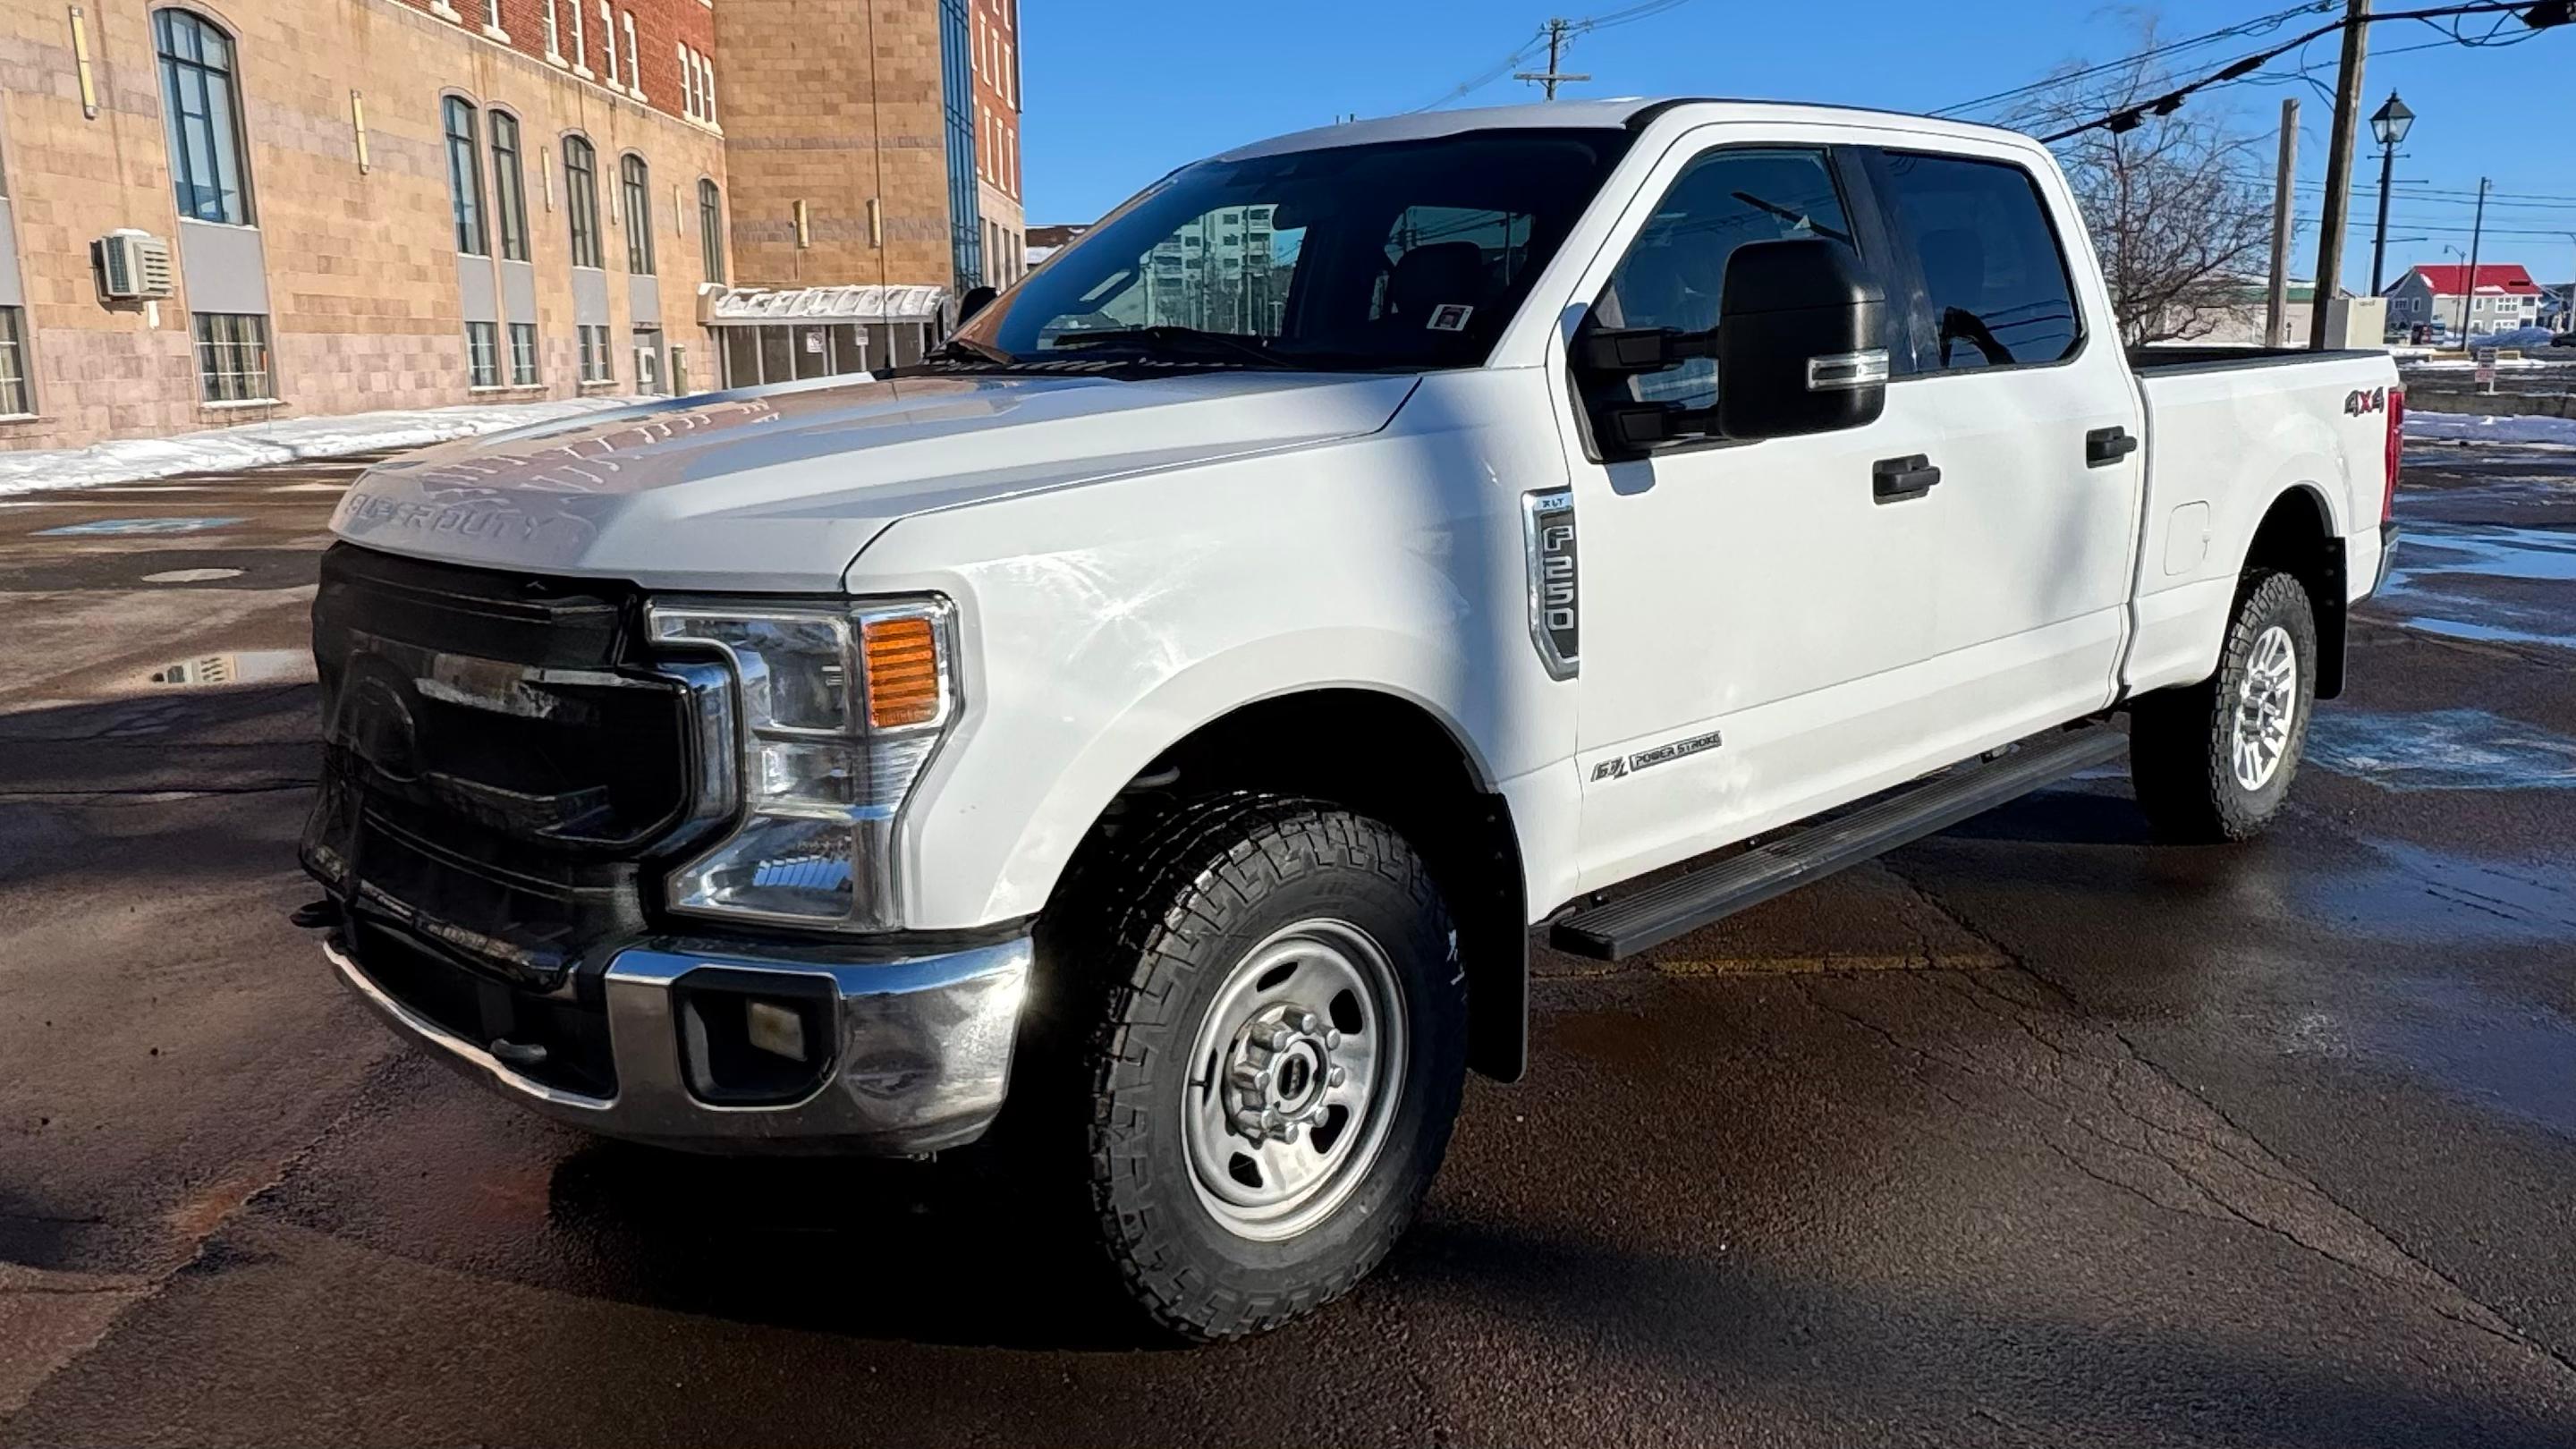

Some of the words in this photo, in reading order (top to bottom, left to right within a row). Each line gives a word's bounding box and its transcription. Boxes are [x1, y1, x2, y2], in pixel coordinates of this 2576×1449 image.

[345, 493, 437, 529] SUPER
[432, 506, 555, 539] DUTY
[1542, 498, 1564, 508] XLT
[1635, 746, 1674, 767] POWER
[1677, 732, 1719, 754] STROKE
